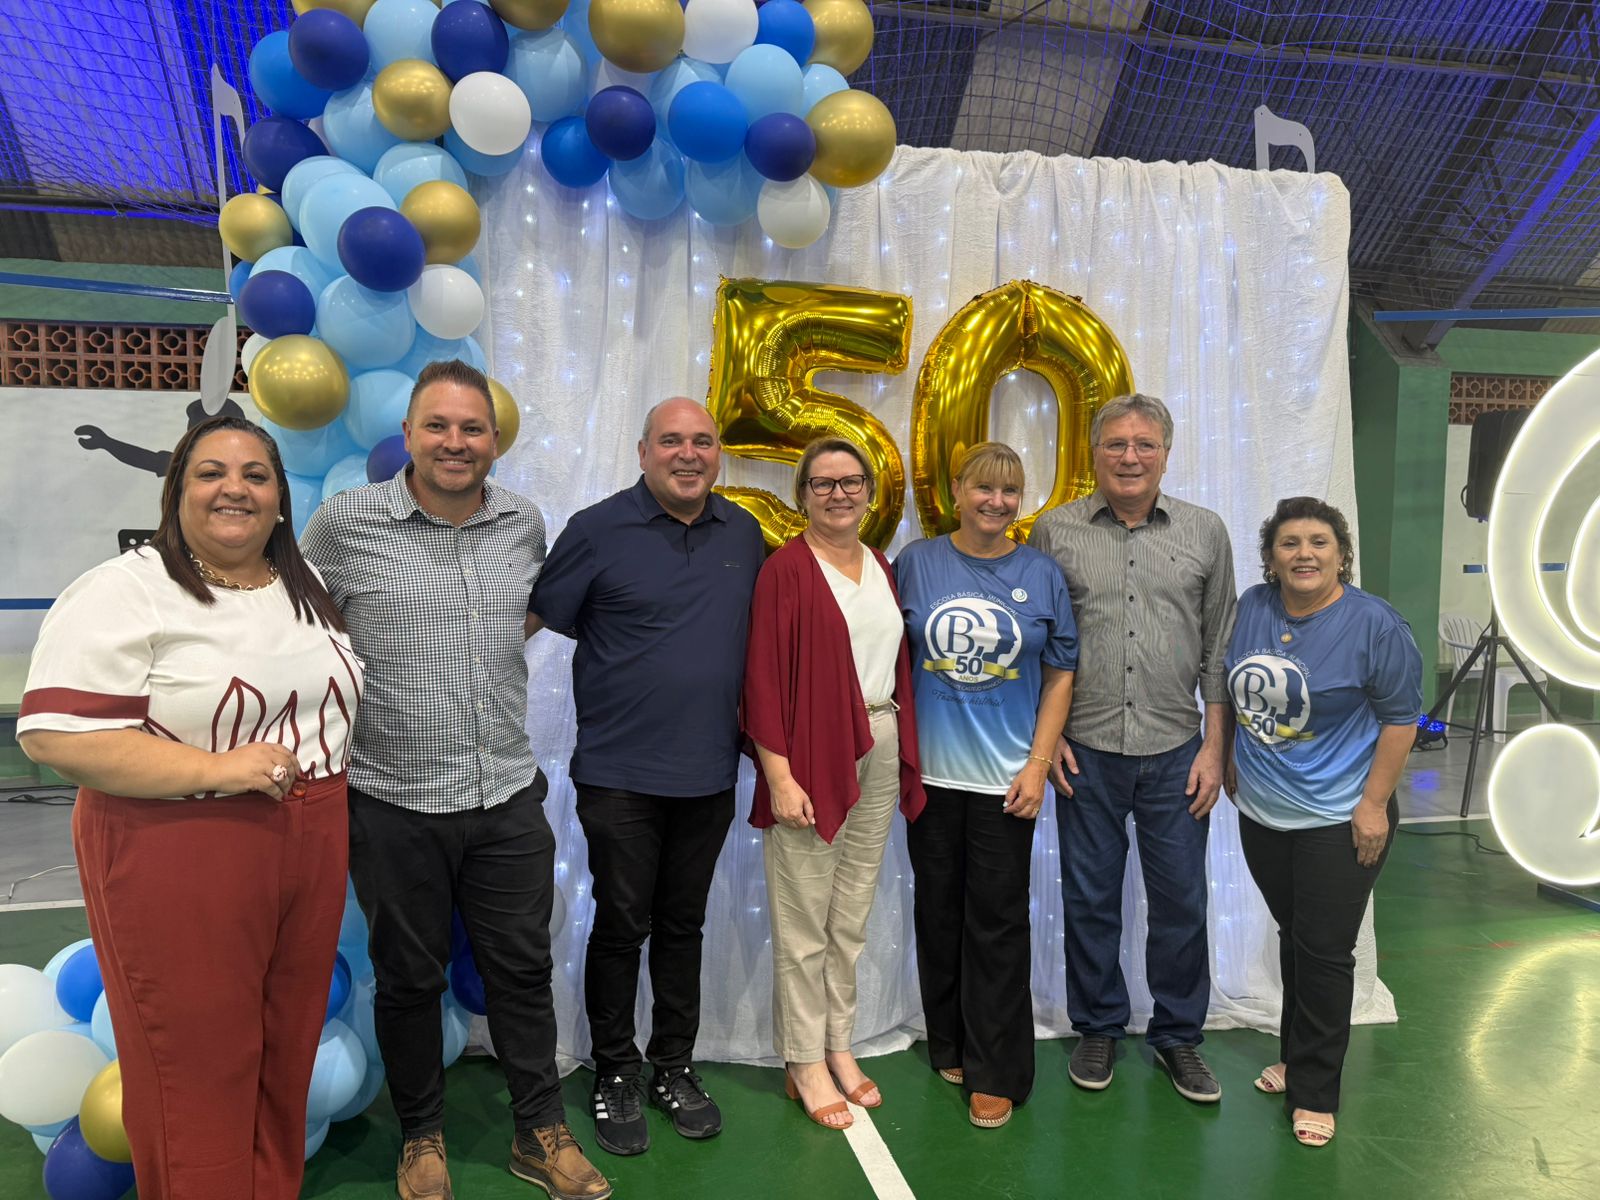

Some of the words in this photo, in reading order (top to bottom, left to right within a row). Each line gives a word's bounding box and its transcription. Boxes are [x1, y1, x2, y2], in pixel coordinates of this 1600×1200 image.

[706, 277, 1135, 551] 50
[930, 594, 956, 610] ESCOLA
[955, 656, 983, 675] 50
[1250, 713, 1276, 737] 50
